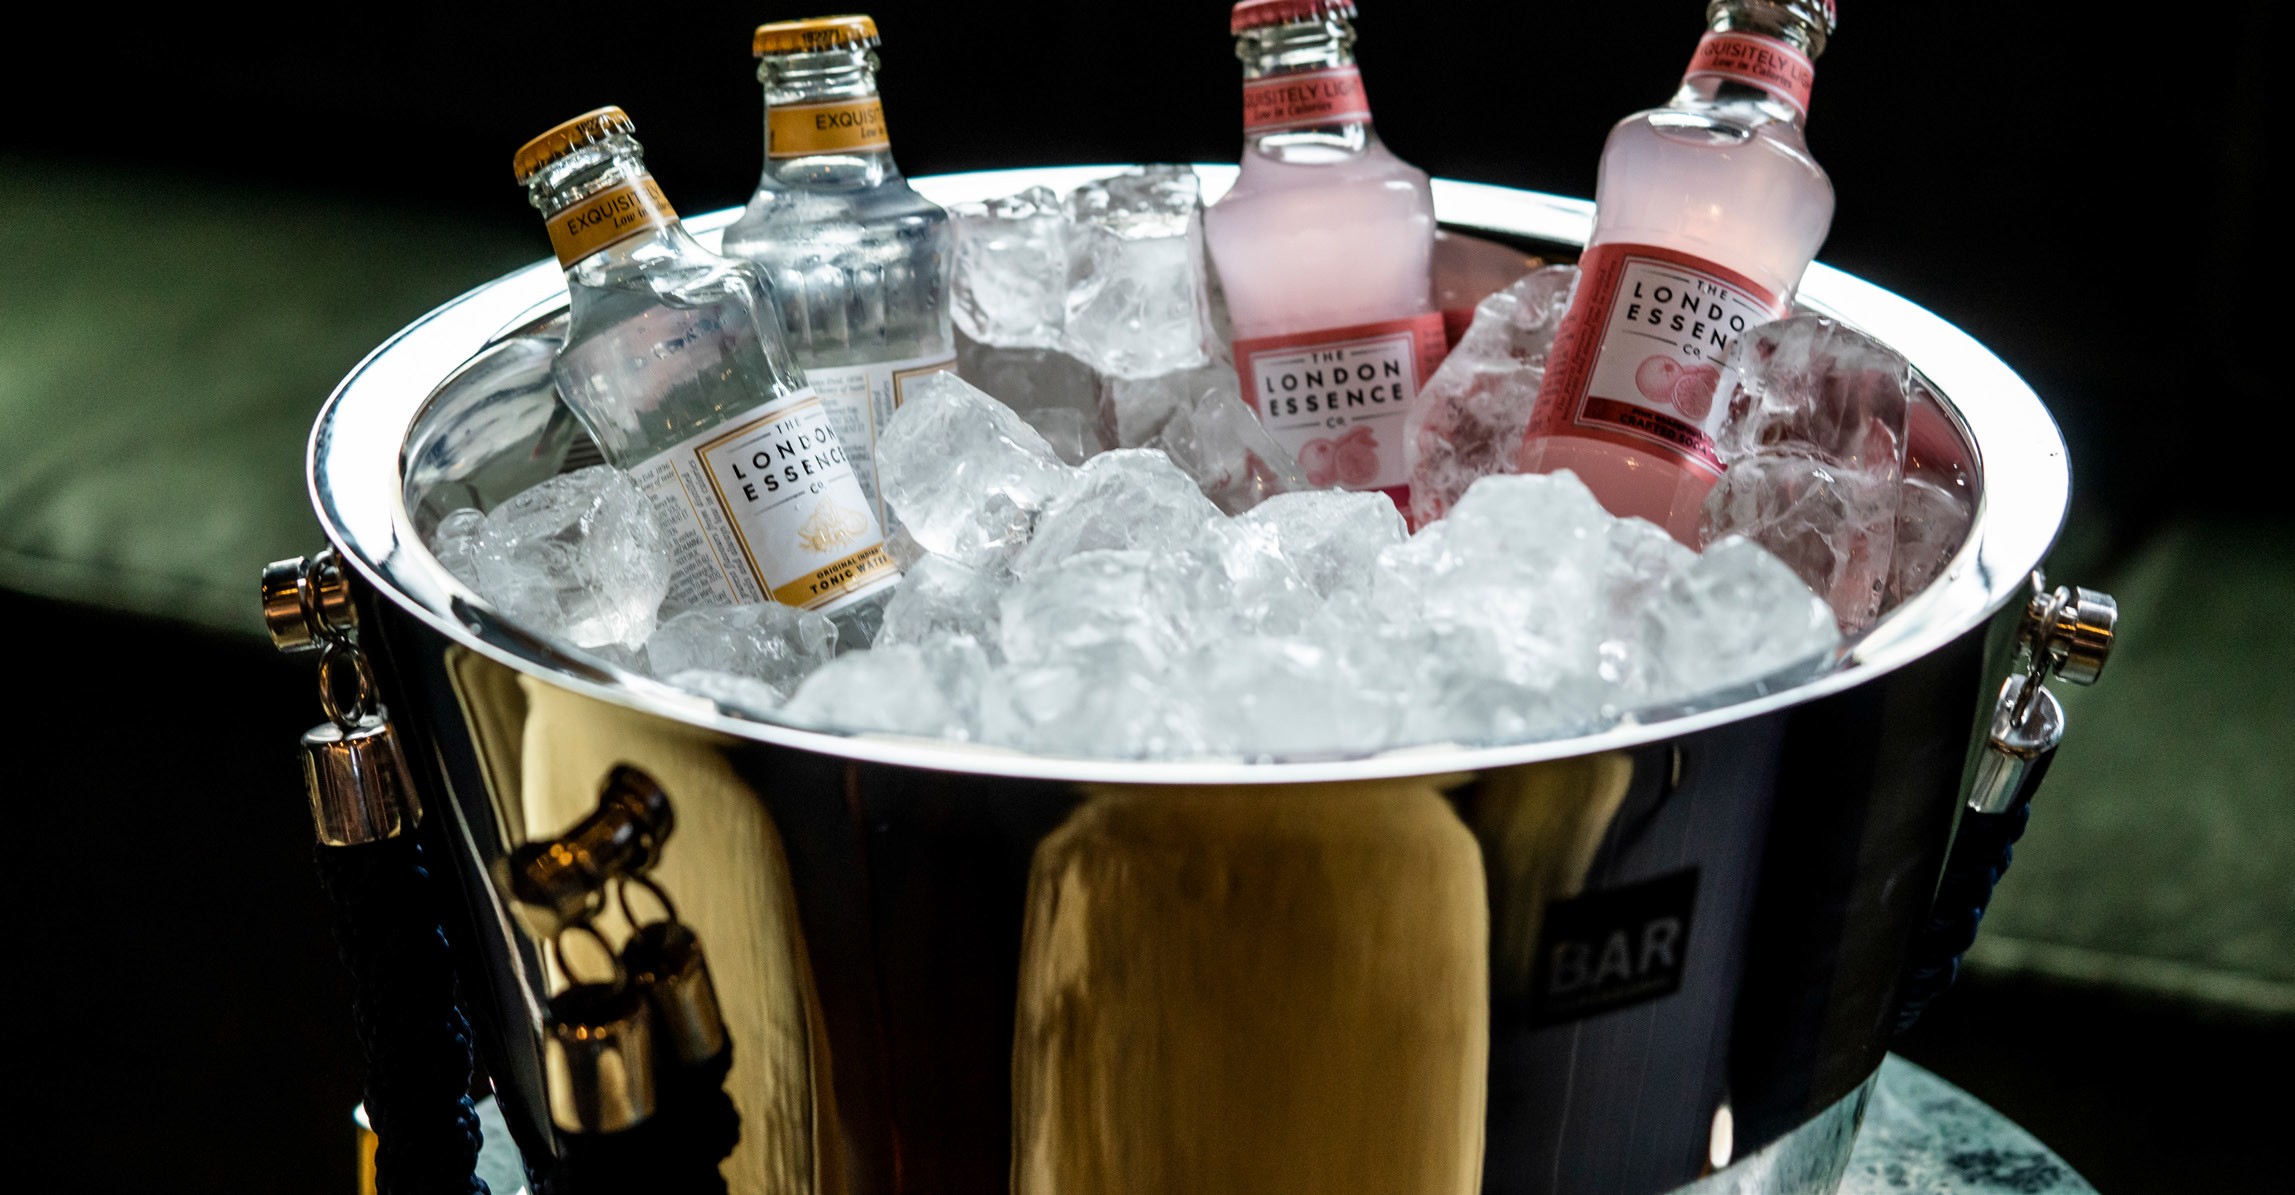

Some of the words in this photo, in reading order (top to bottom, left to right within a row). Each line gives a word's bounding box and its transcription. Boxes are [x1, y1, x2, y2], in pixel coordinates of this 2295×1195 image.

[566, 185, 662, 236] EXQUISITLY
[613, 212, 636, 229] Low
[1633, 281, 1753, 332] LONDO
[1696, 279, 1728, 300] THE
[1310, 349, 1346, 364] THE
[1265, 359, 1402, 394] LONDON
[1268, 382, 1404, 418] ESSENCE
[774, 417, 803, 434] THE
[1619, 413, 1676, 439] CRAFTED
[1678, 433, 1707, 455] SODA
[731, 424, 837, 480] LONDON
[742, 446, 847, 503] ESSENCE
[808, 569, 854, 594] TONIC
[856, 555, 888, 573] WATER
[816, 557, 857, 580] ORIGINAL
[857, 547, 880, 562] INDIAN
[1548, 914, 1682, 994] BAR
